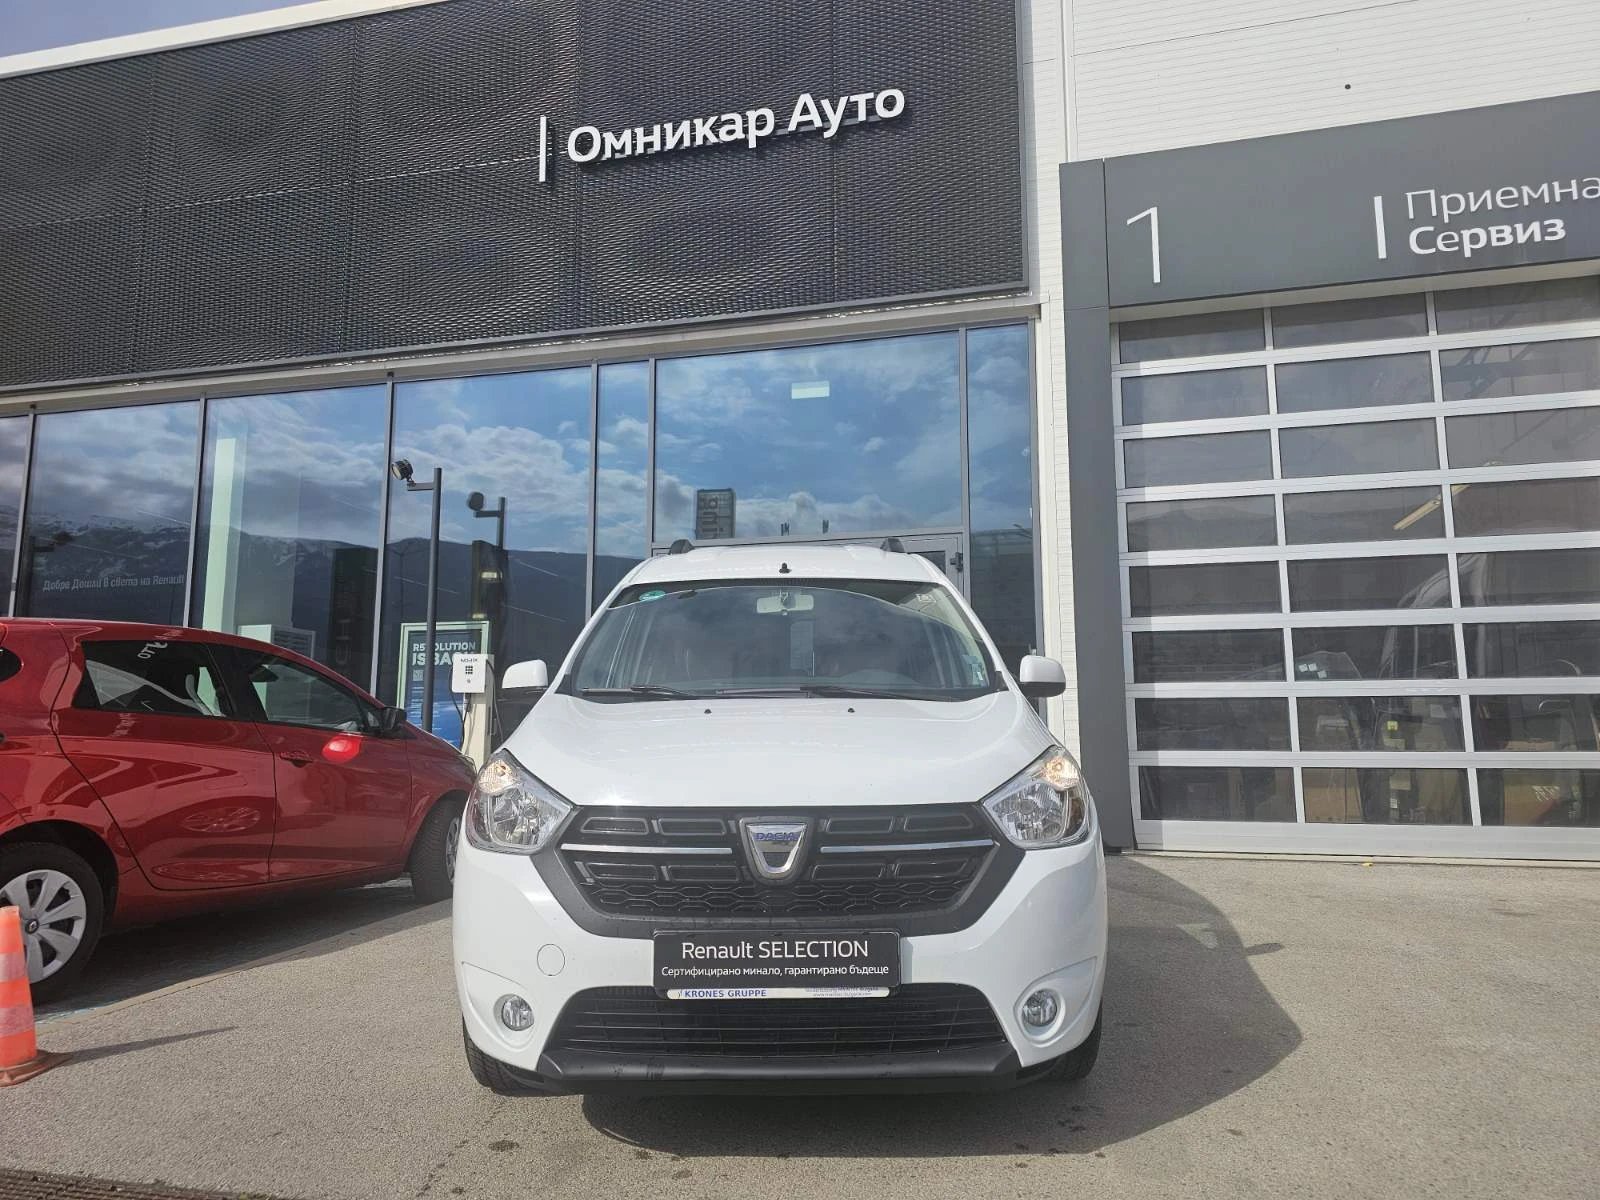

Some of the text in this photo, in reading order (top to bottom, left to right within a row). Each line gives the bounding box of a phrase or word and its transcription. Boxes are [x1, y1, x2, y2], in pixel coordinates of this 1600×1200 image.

[567, 88, 905, 163] Омникар Ауто
[1405, 176, 1600, 223] Приемна
[1126, 206, 1161, 283] 1
[1408, 218, 1567, 258] Сервиз
[413, 642, 475, 652] R5OLUTION
[681, 940, 869, 959] Renault SELECTION
[661, 964, 889, 979] Сертифицирано минало, гарантирано бъдеще
[684, 988, 767, 999] KRONES GRUPPE
